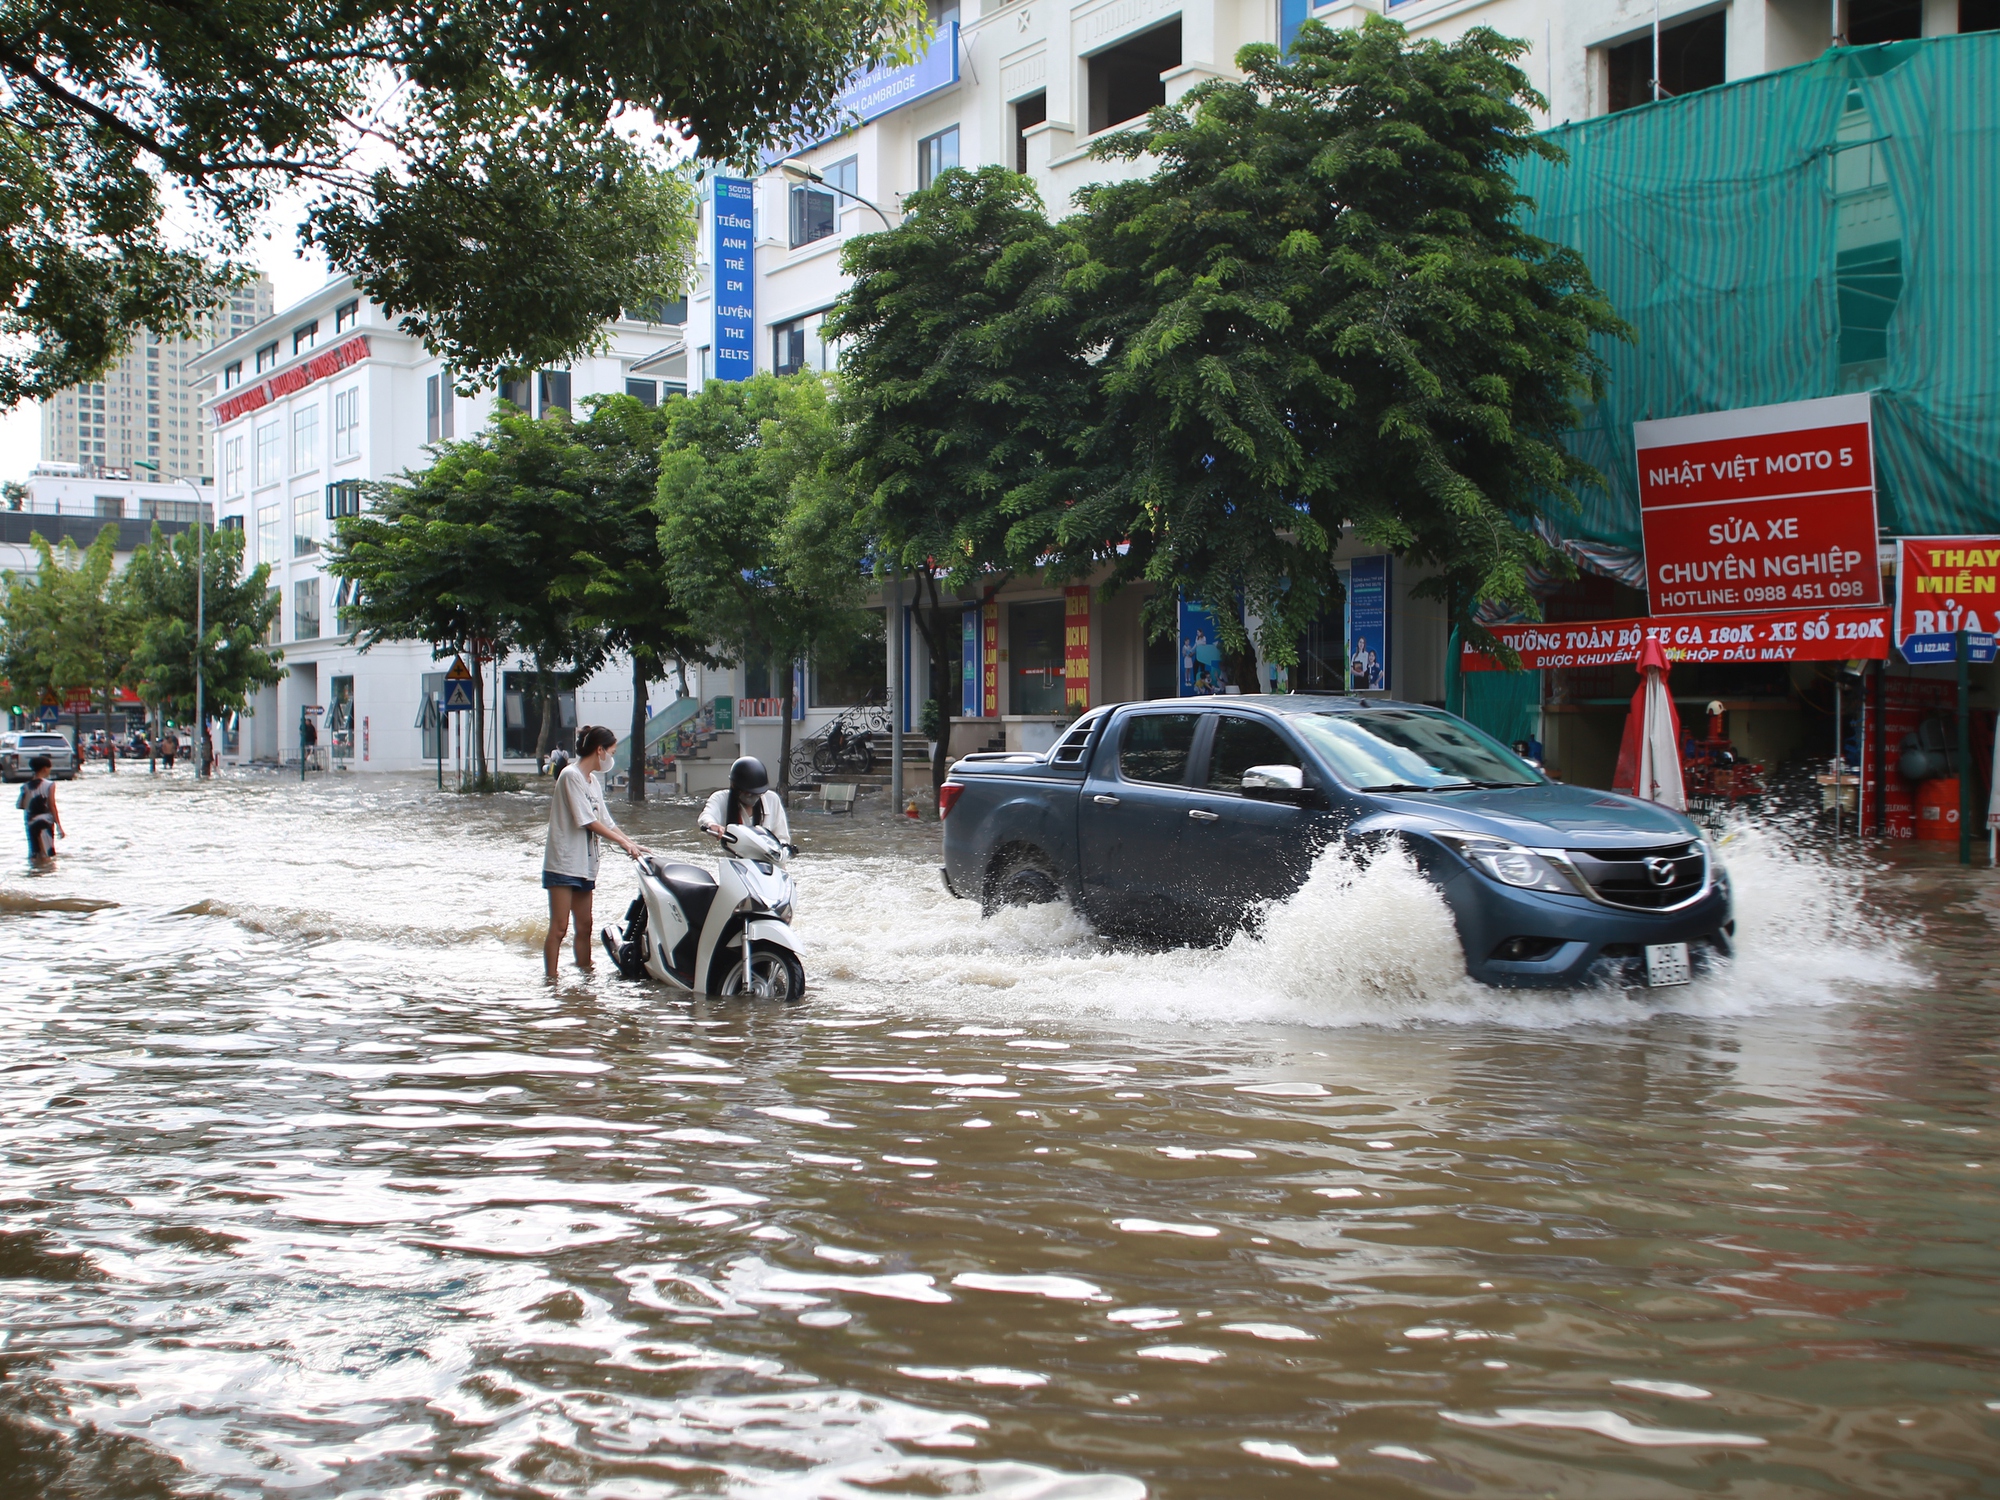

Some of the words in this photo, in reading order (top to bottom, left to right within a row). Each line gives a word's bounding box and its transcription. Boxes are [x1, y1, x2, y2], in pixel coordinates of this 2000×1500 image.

[857, 77, 870, 92] TẠO
[871, 69, 882, 84] VÀ
[860, 74, 916, 110] CAMBRIDGE
[728, 185, 751, 194] SCOTS
[728, 192, 751, 200] ENGLISH
[717, 214, 751, 229] TIẾNG
[722, 237, 746, 250] ANH
[724, 258, 745, 271] TRẺ
[727, 280, 743, 292] EM
[717, 305, 752, 320] LUYỆN
[724, 327, 745, 339] THI
[719, 348, 750, 361] IELTS
[270, 364, 307, 399] BILLIARDS
[308, 350, 340, 381] FITNESS
[340, 335, 370, 366] YOGA
[1649, 460, 1706, 488] NHẬT
[1711, 454, 1760, 483] VIỆT
[1765, 450, 1833, 475] MOTO
[1839, 448, 1854, 467] 5
[1708, 517, 1760, 545] SỬA
[1766, 518, 1799, 540] XE
[1659, 553, 1756, 584] CHUYÊN
[1763, 545, 1862, 579] NGHIỆP
[1928, 549, 2000, 568] THAY
[1916, 569, 1996, 594] MIỄN
[1661, 588, 1739, 607] HOTLINE:
[1743, 585, 1787, 602] 0988
[1791, 583, 1825, 600] 451
[1829, 581, 1864, 598] 098
[986, 626, 995, 645] VỤ
[1065, 626, 1079, 651] DỊCH
[1080, 625, 1088, 650] VỤ
[1502, 629, 1561, 652] DƯỠNG
[1565, 626, 1615, 650] TOÀN
[1617, 623, 1642, 650] BỘ
[1675, 626, 1703, 644] GA
[1708, 624, 1755, 644] 180K
[1768, 622, 1798, 642] XE
[1802, 612, 1831, 641] SỐ
[1834, 618, 1885, 641] 120K
[984, 646, 997, 665] LÀM
[1536, 654, 1574, 669] ĐƯỢC
[1576, 647, 1632, 665] KHUYẾN
[1686, 648, 1720, 663] HỘP
[1760, 645, 1797, 660] MÁY
[985, 665, 995, 688] SỔ
[738, 698, 756, 718] FIT
[756, 697, 785, 718] CITY
[985, 689, 996, 711] ĐỎ
